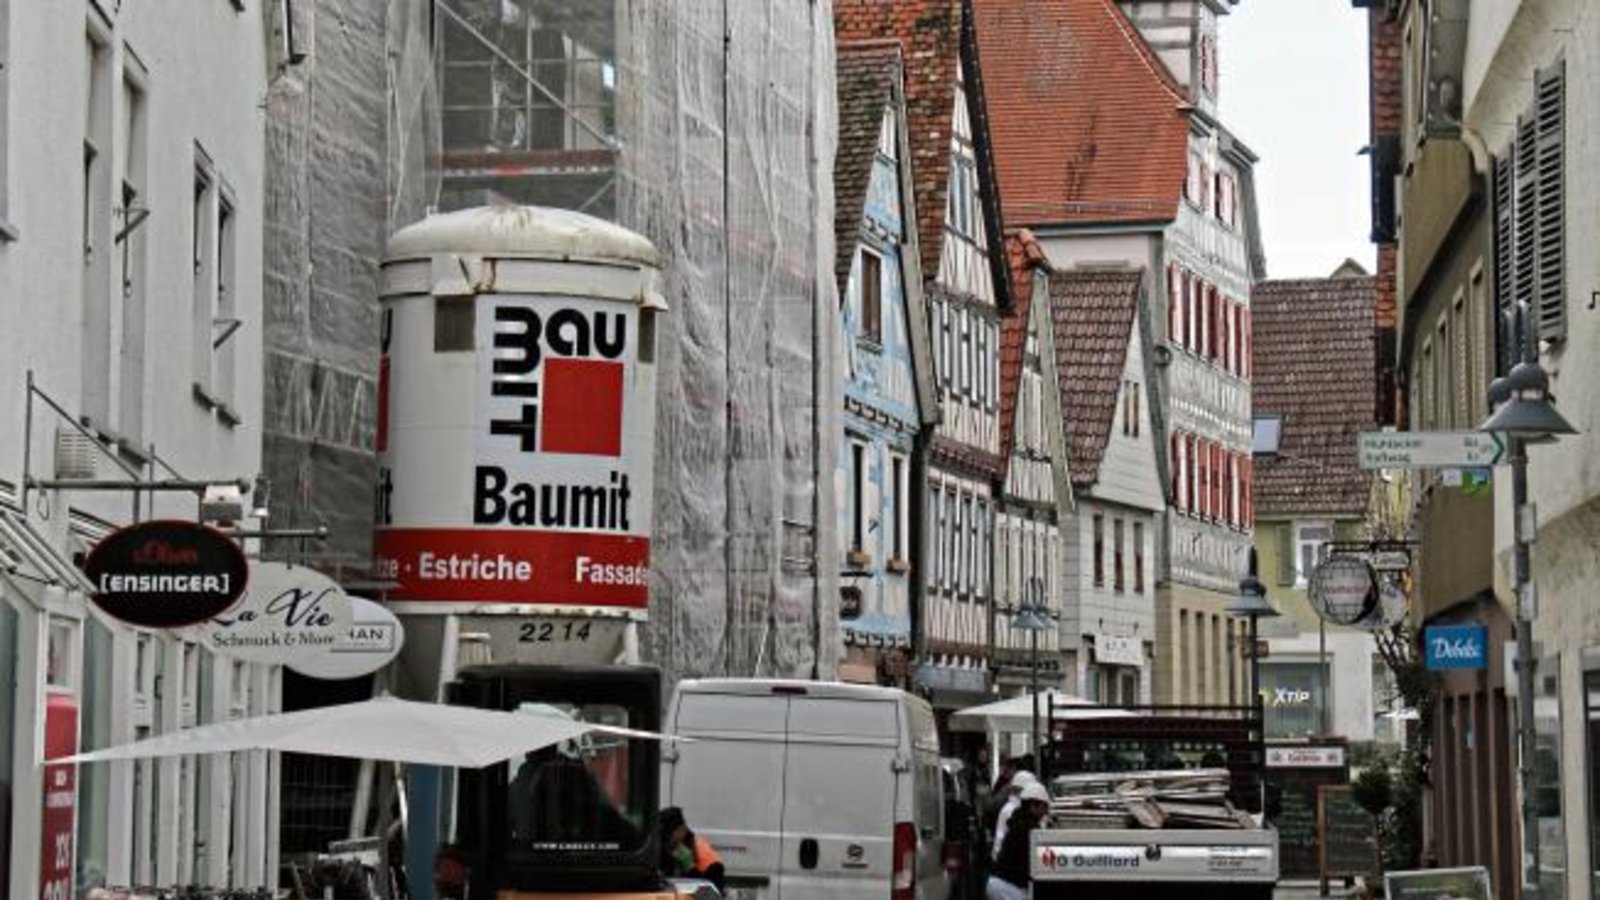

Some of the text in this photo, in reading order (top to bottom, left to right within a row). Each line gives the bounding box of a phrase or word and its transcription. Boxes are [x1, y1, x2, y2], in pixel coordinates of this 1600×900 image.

[473, 465, 631, 531] Baumit
[419, 551, 533, 581] Estriche
[265, 587, 338, 627] Vie
[212, 632, 284, 647] Schmuck
[284, 634, 296, 646] &
